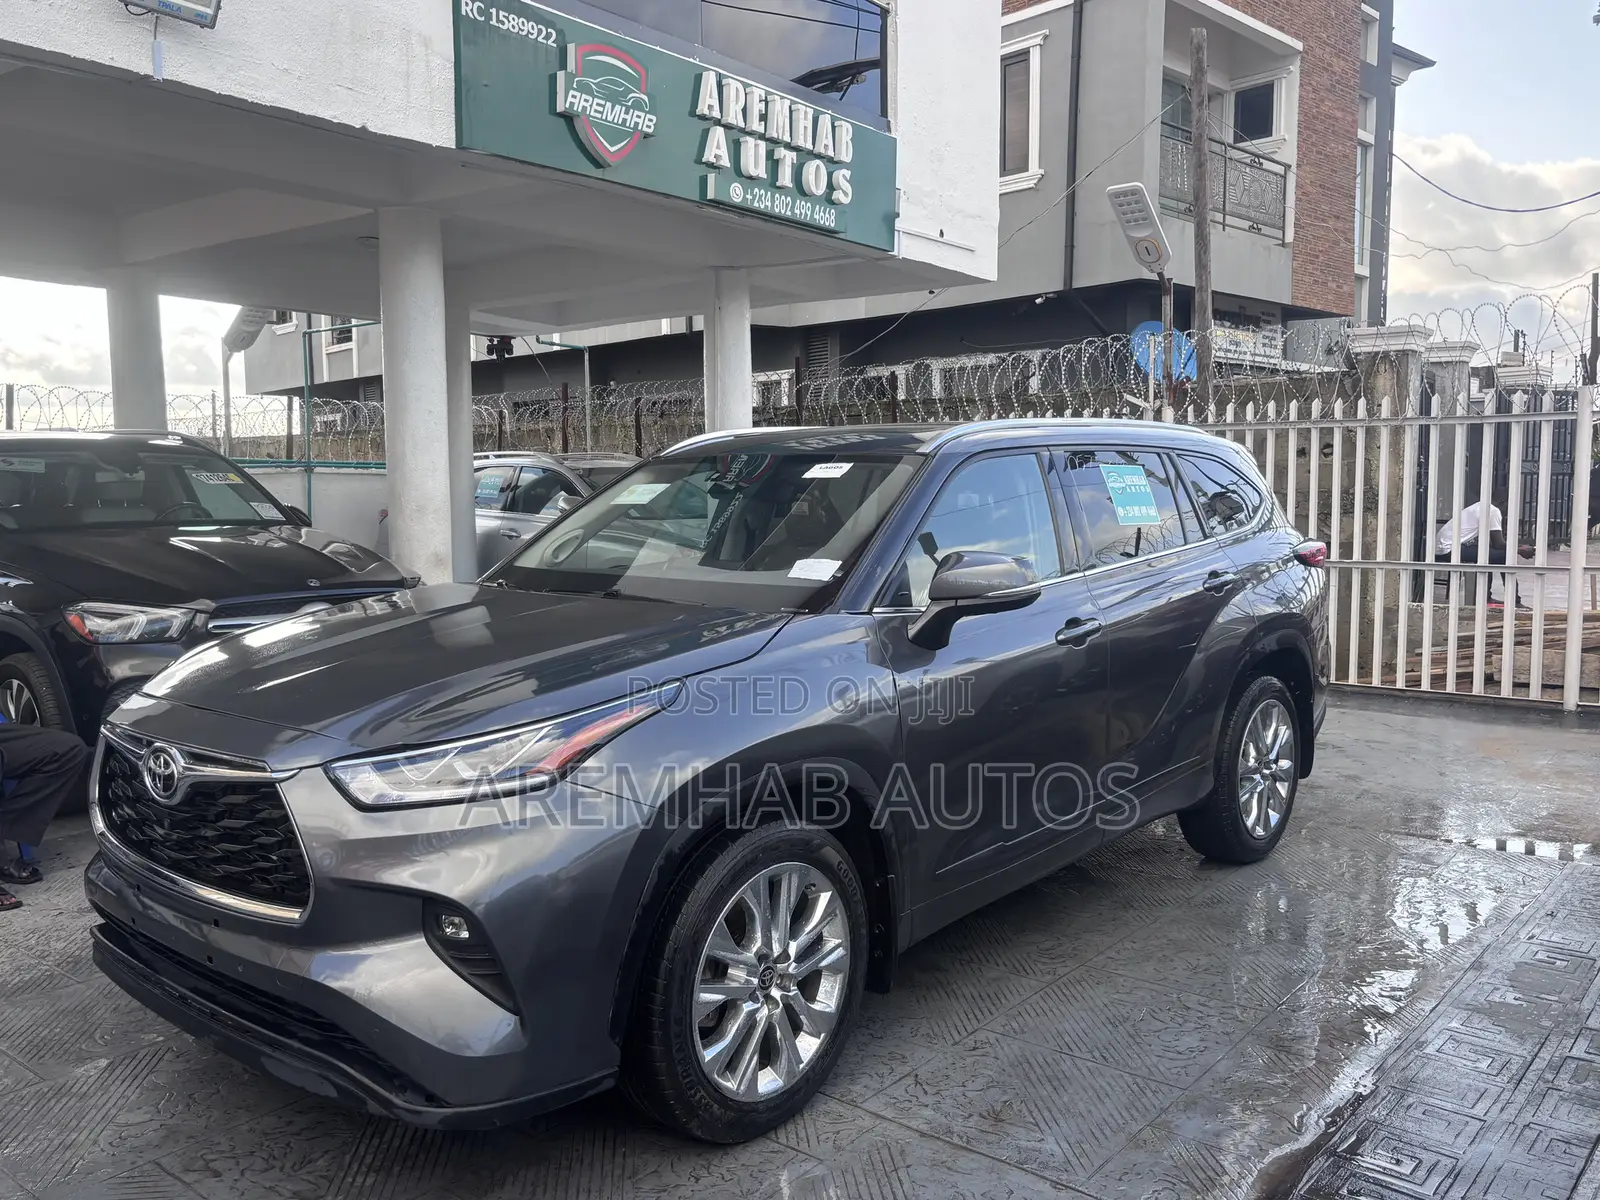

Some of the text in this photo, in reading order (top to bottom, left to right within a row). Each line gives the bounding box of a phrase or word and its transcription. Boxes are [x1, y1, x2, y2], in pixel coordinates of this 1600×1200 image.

[461, 0, 557, 48] RC 1589922
[565, 89, 657, 133] AREMHAB
[696, 70, 854, 164] AREMHAB
[702, 126, 853, 205] AUTOS
[745, 187, 836, 228] +234 802 499 4668
